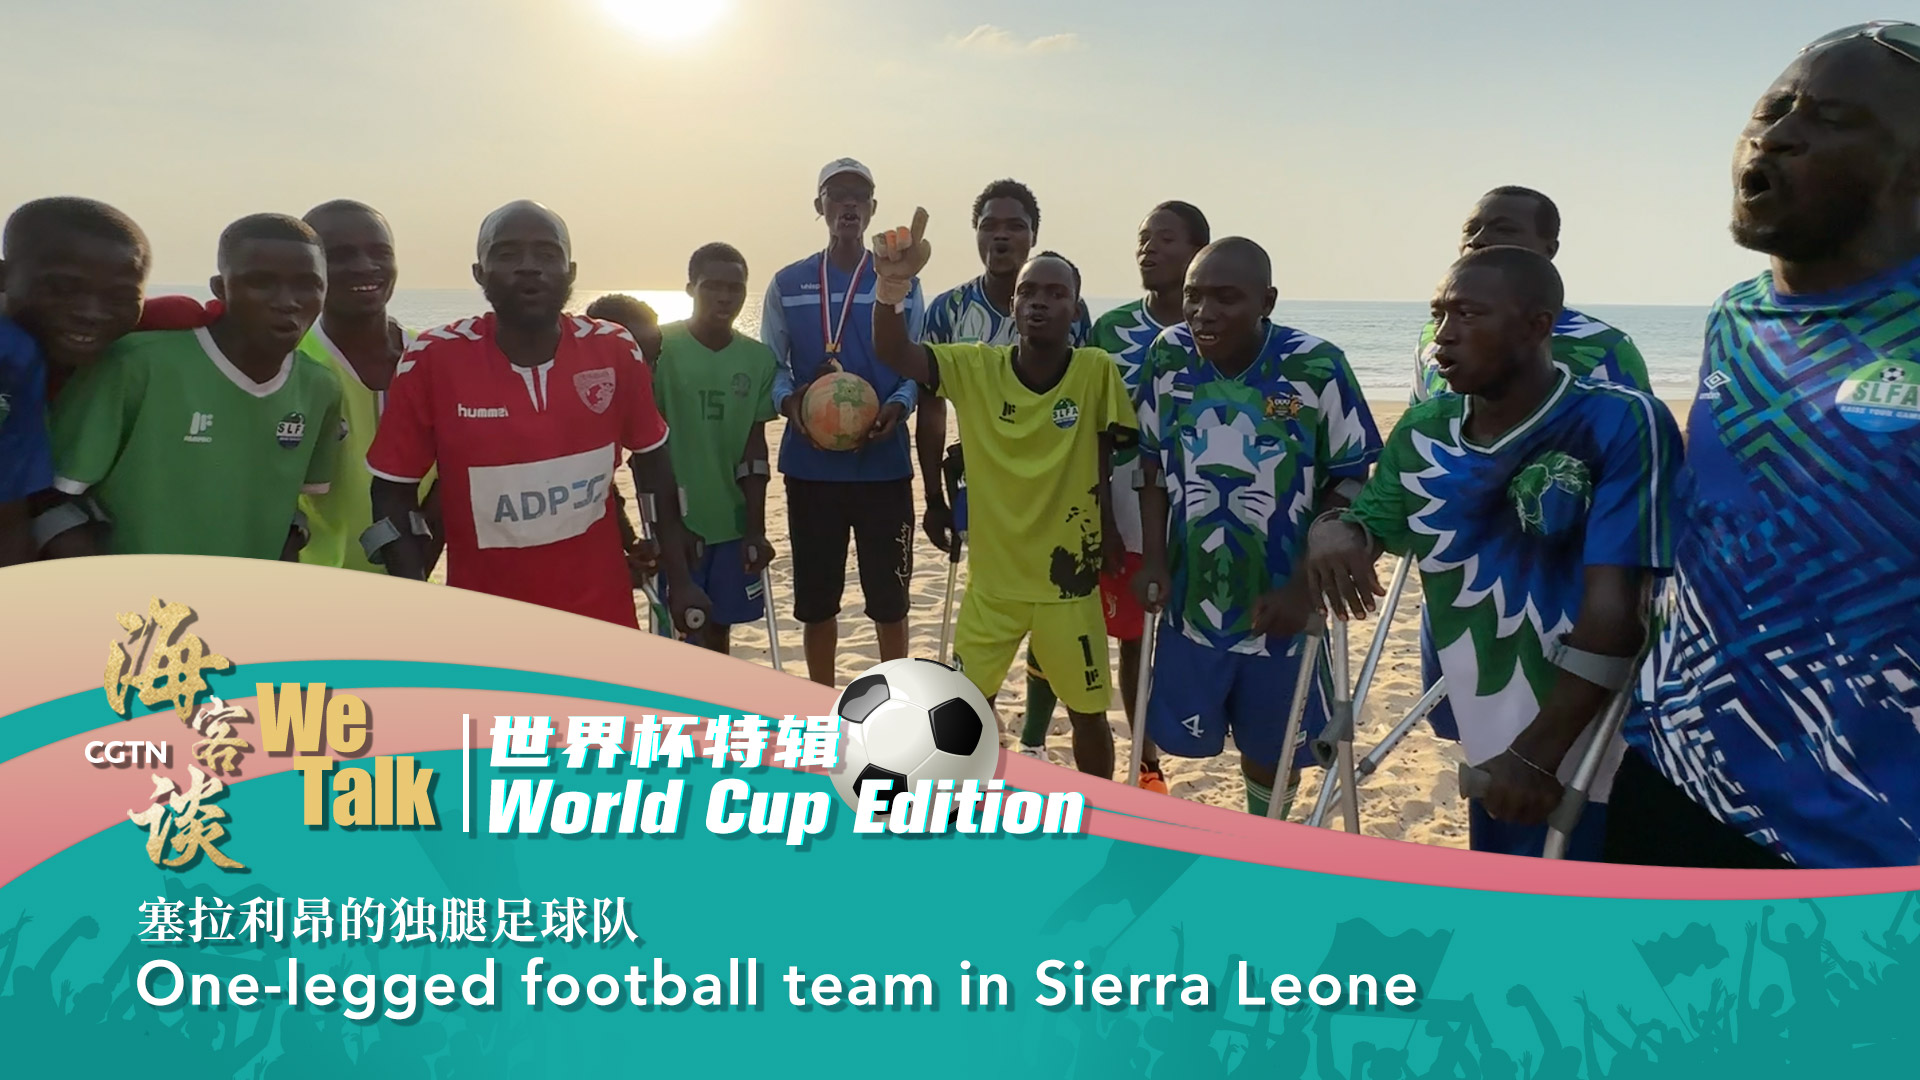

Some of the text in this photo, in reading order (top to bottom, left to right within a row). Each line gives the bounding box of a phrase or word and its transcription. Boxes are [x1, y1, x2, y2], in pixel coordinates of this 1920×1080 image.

[698, 390, 725, 420] 15
[1852, 381, 1919, 406] SLFA
[457, 403, 509, 418] hummel
[1052, 407, 1079, 419] SLFA
[1181, 713, 1204, 738] 4
